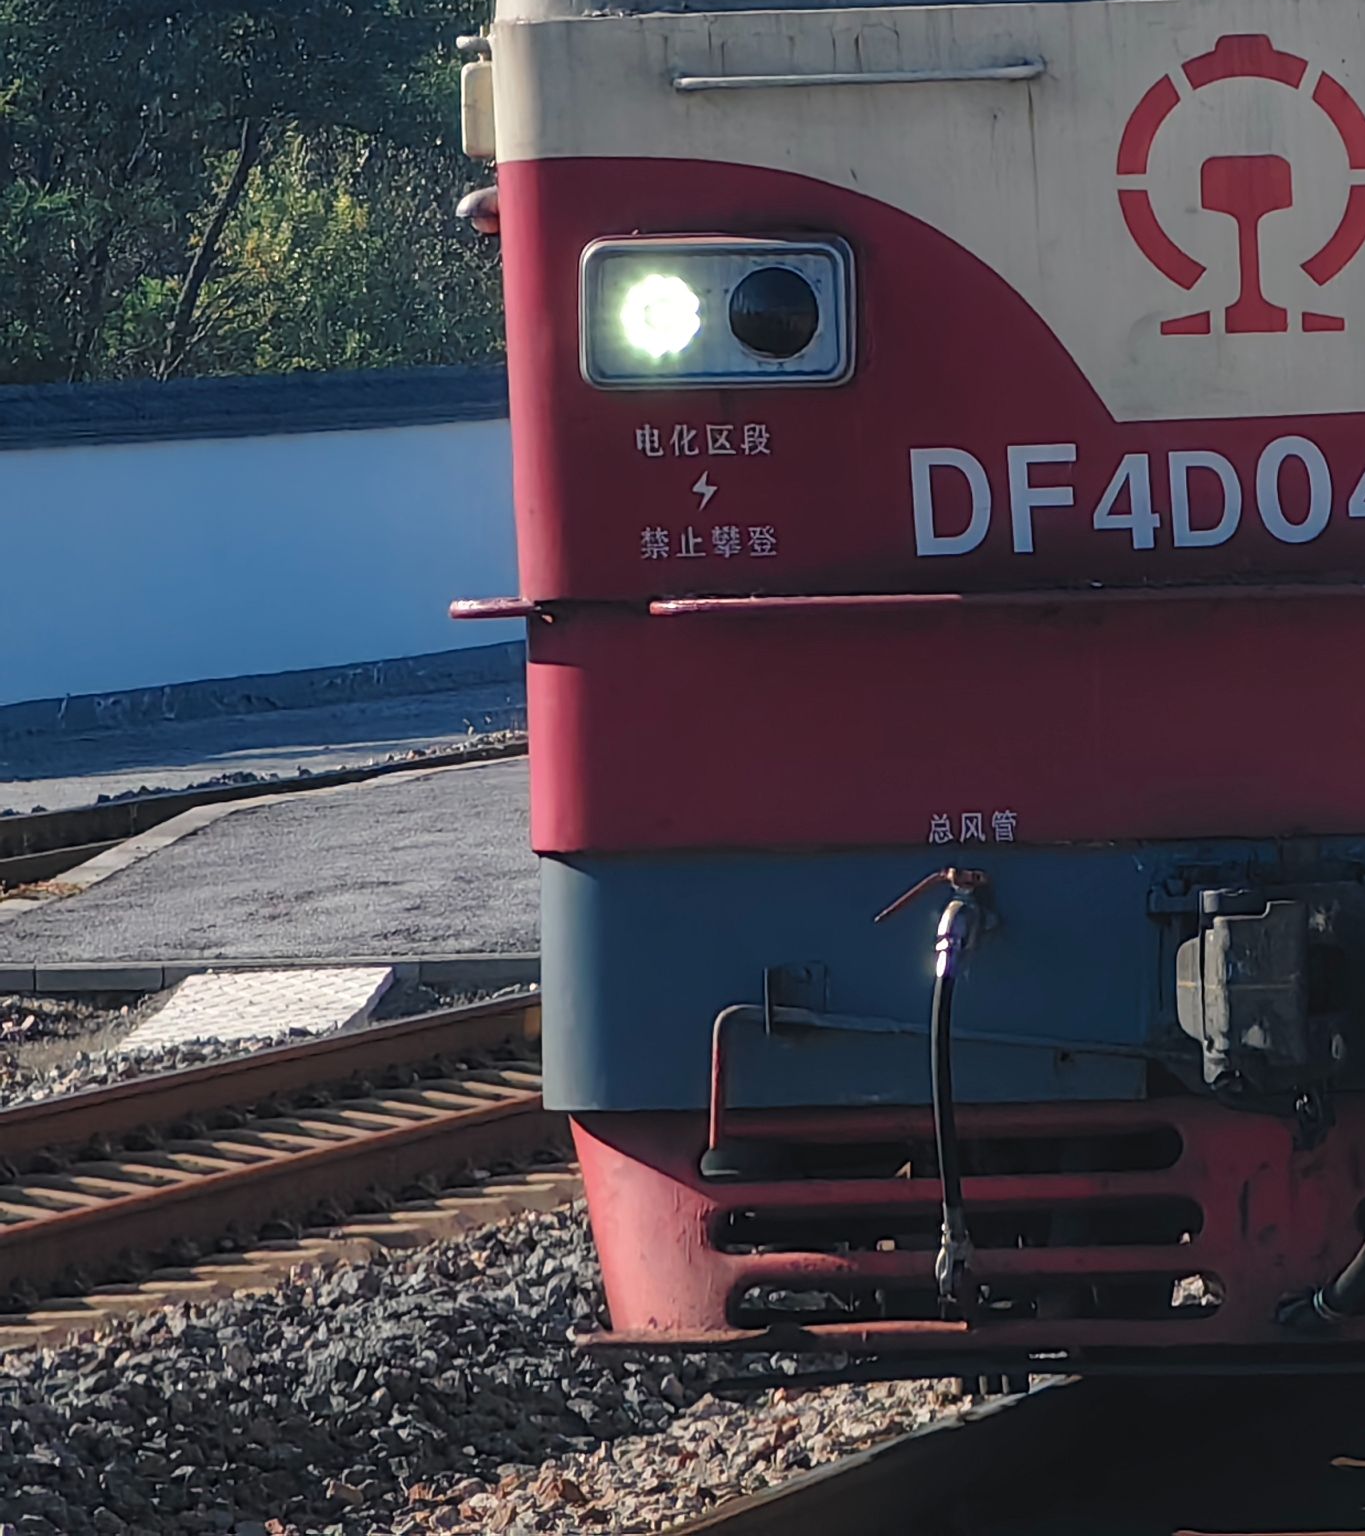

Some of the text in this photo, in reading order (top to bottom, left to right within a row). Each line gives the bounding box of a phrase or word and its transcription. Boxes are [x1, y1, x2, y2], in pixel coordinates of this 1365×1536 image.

[635, 424, 772, 458] 电化区段
[640, 525, 777, 560] 禁止攀登
[928, 810, 1018, 844] 总风管
